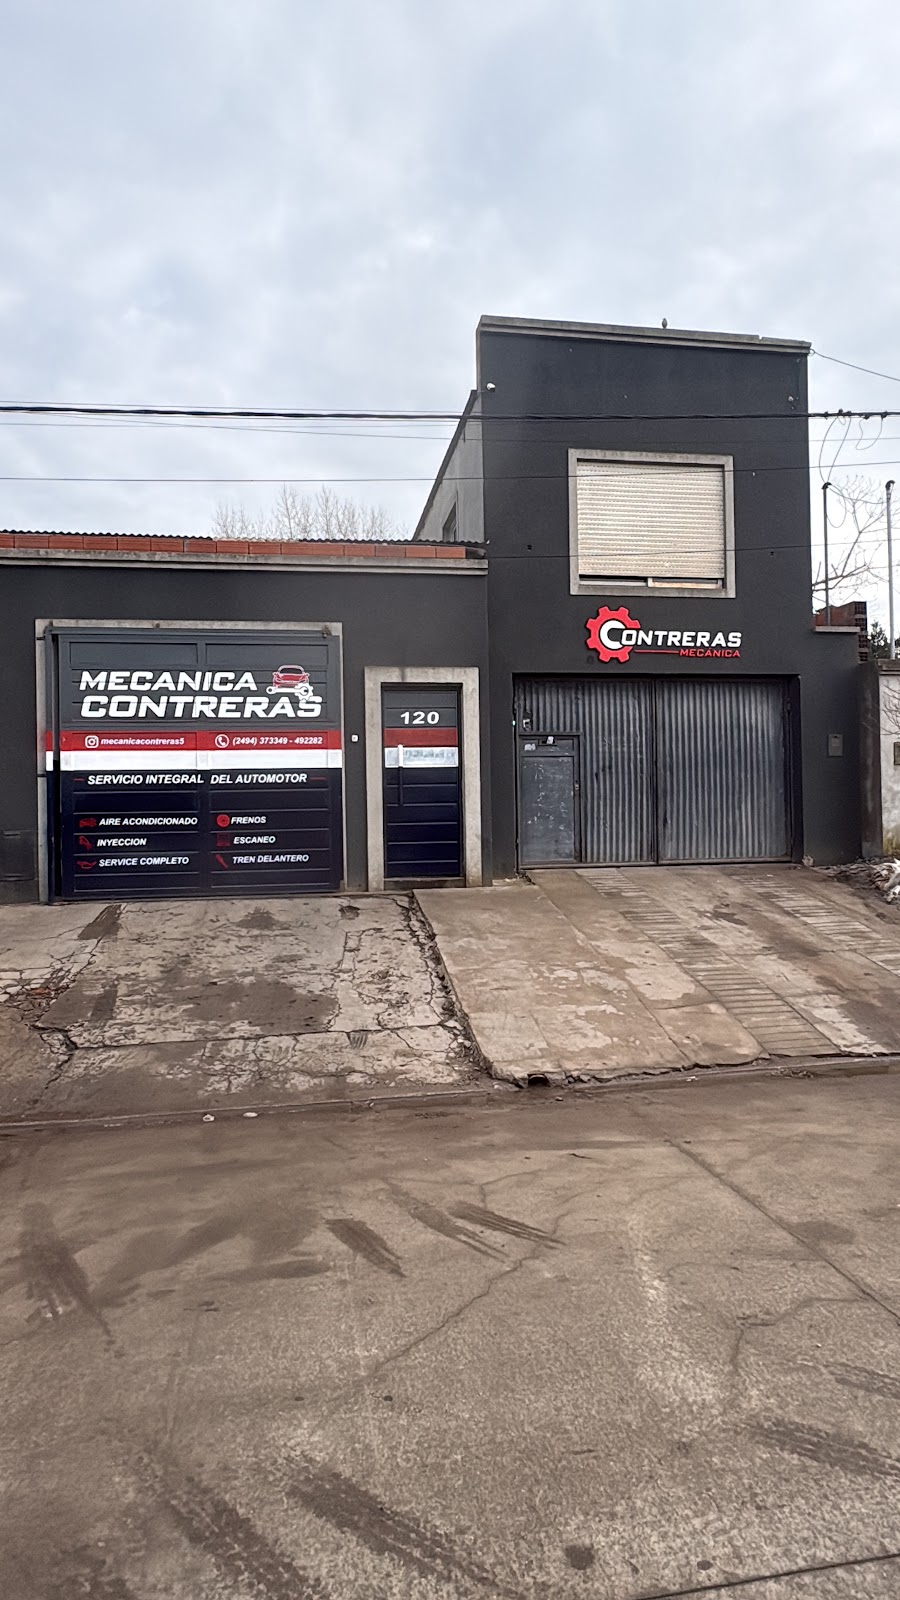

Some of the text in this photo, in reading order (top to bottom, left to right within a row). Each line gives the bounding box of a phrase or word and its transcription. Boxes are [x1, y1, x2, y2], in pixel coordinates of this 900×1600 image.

[600, 620, 742, 650] CONTRERAS
[679, 648, 741, 658] MECÁNICA
[79, 671, 258, 691] MECANICA
[80, 695, 323, 718] CONTRERAS
[400, 711, 440, 725] 120
[100, 737, 185, 746] mecanicacontreras5
[232, 737, 258, 747] (2494)
[259, 737, 288, 745] 373349
[294, 736, 323, 745] 492282
[87, 773, 308, 785] SERVICIO INTEGRAL DEL AUTOMOTOR
[98, 817, 199, 826] AIRE ACONDICIONADO
[230, 816, 267, 825] FRENOS
[96, 838, 147, 847] INYECCION
[233, 836, 276, 844] ESCANEO
[98, 856, 190, 867] SERVICE COMPLETO
[232, 854, 310, 864] TREN DELANTERO
